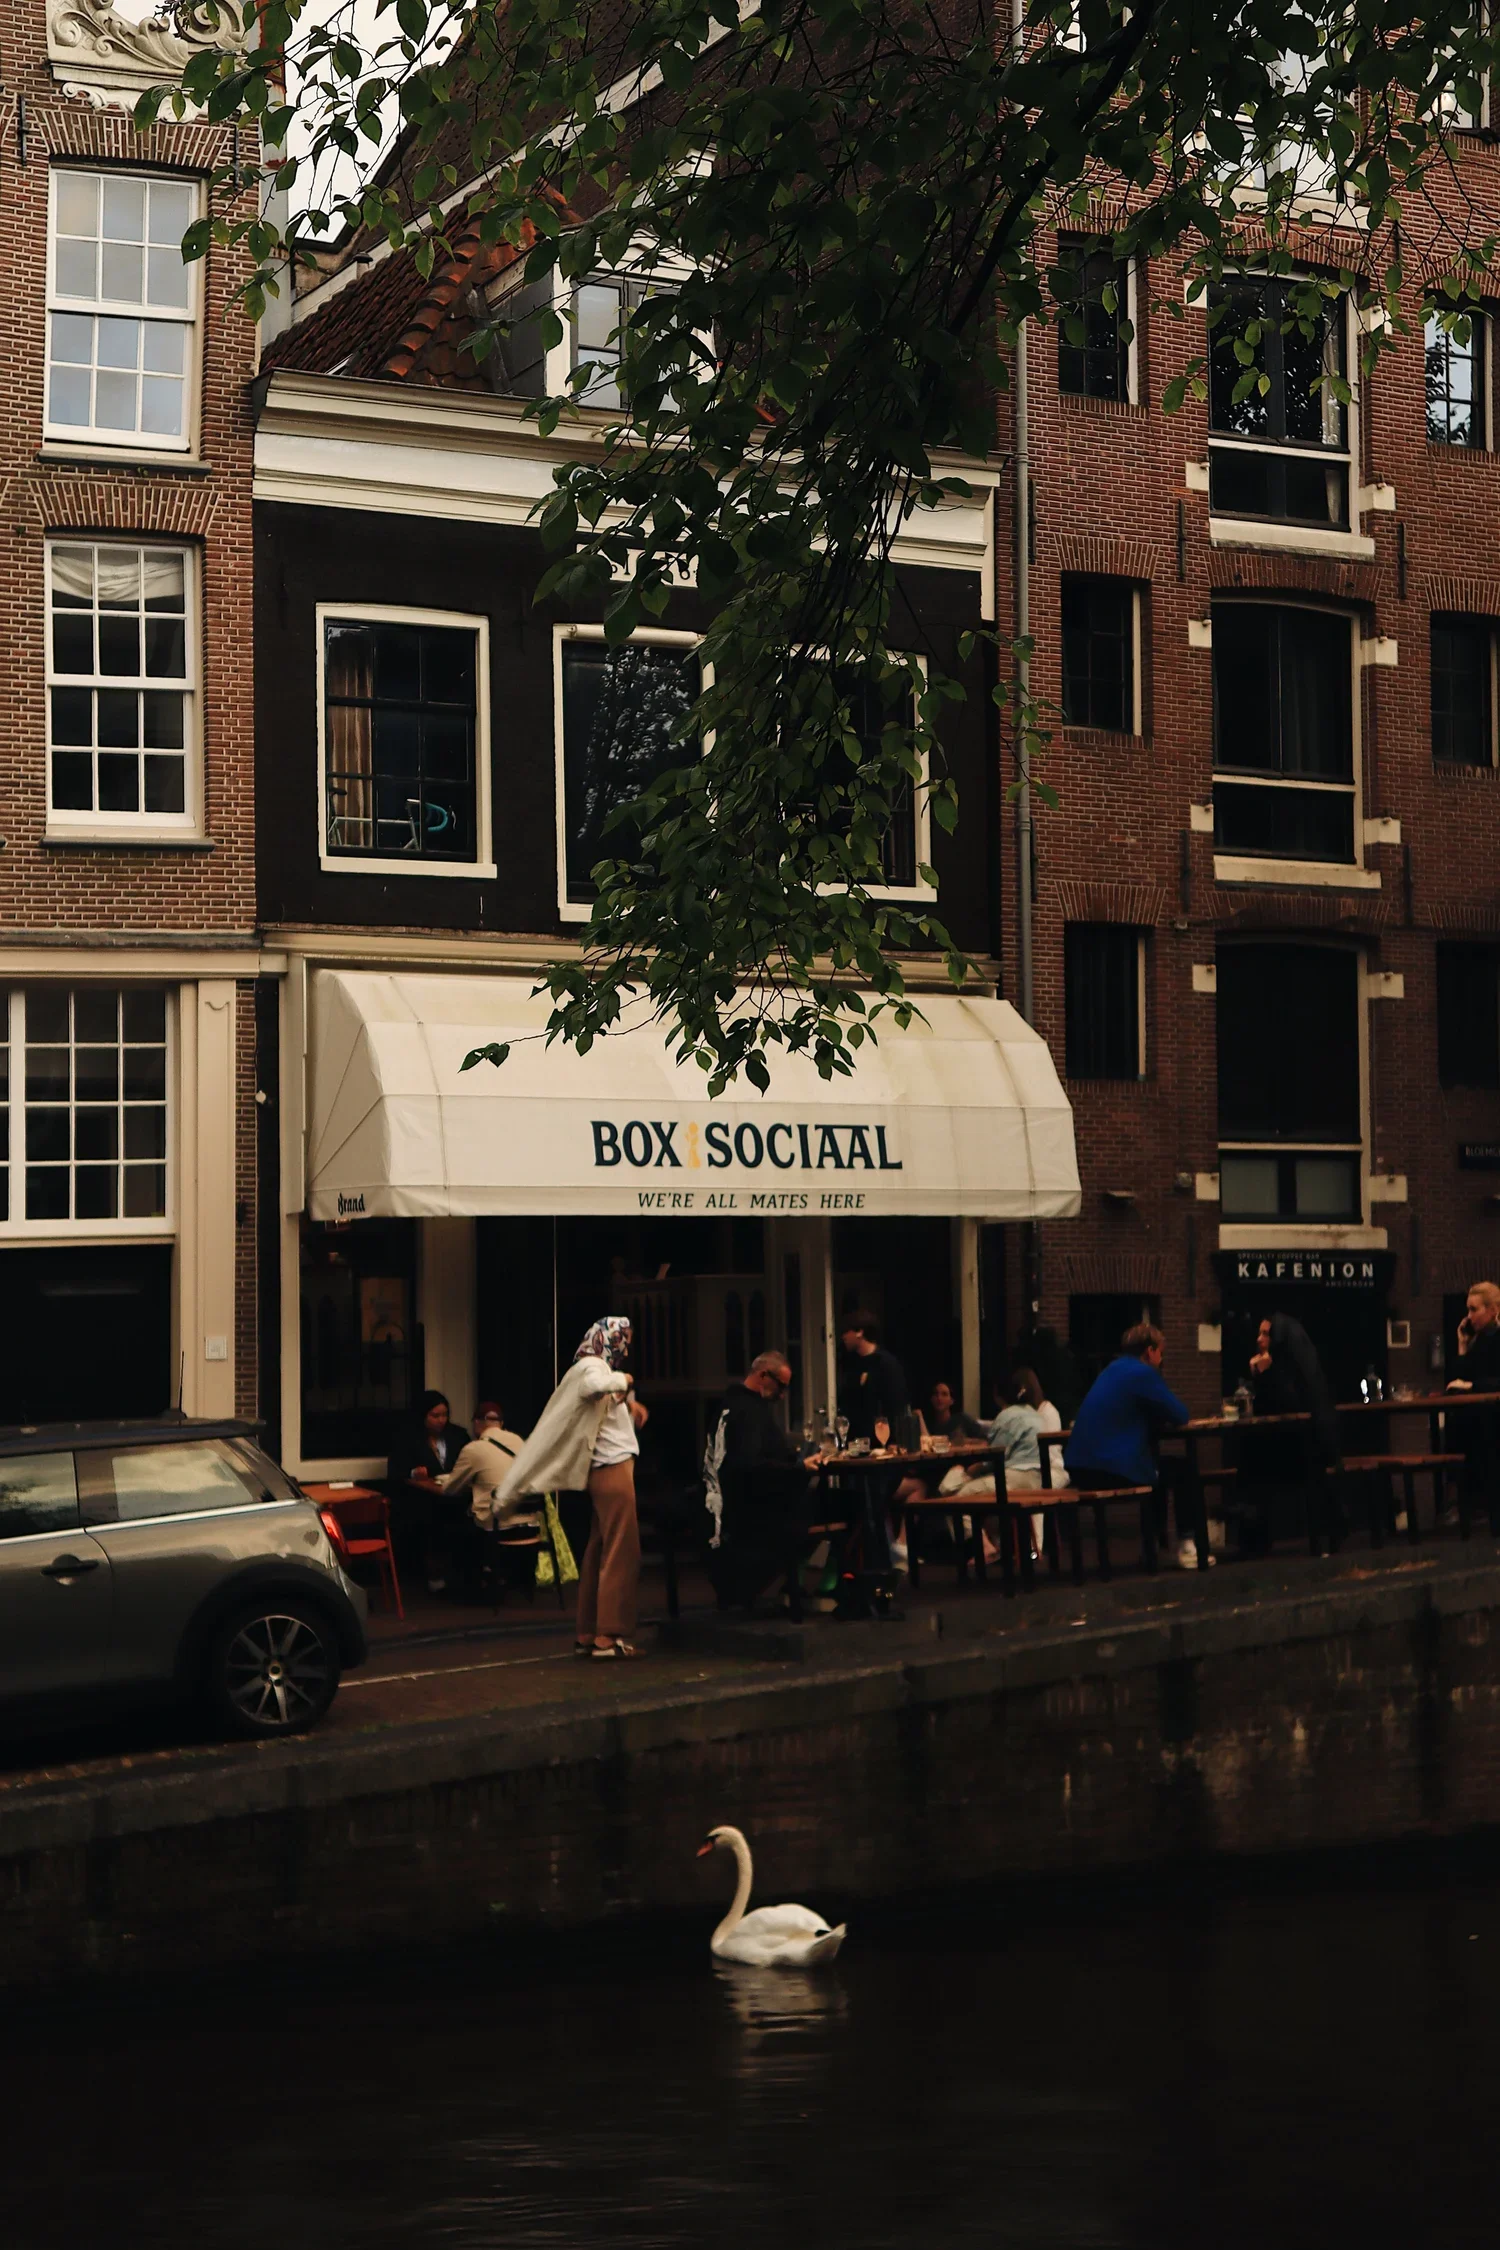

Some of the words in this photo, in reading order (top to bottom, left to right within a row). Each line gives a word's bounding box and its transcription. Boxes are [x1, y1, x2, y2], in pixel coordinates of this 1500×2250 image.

[590, 1120, 683, 1168] BOX
[704, 1121, 903, 1170] SOCIAAL
[337, 1192, 366, 1217] Brand
[637, 1192, 694, 1209] WE'RE
[705, 1193, 738, 1209] ALL
[750, 1193, 808, 1209] MATES
[820, 1193, 866, 1209] HERE
[1277, 1252, 1303, 1260] COFFEE
[1238, 1262, 1374, 1278] KAFENION
